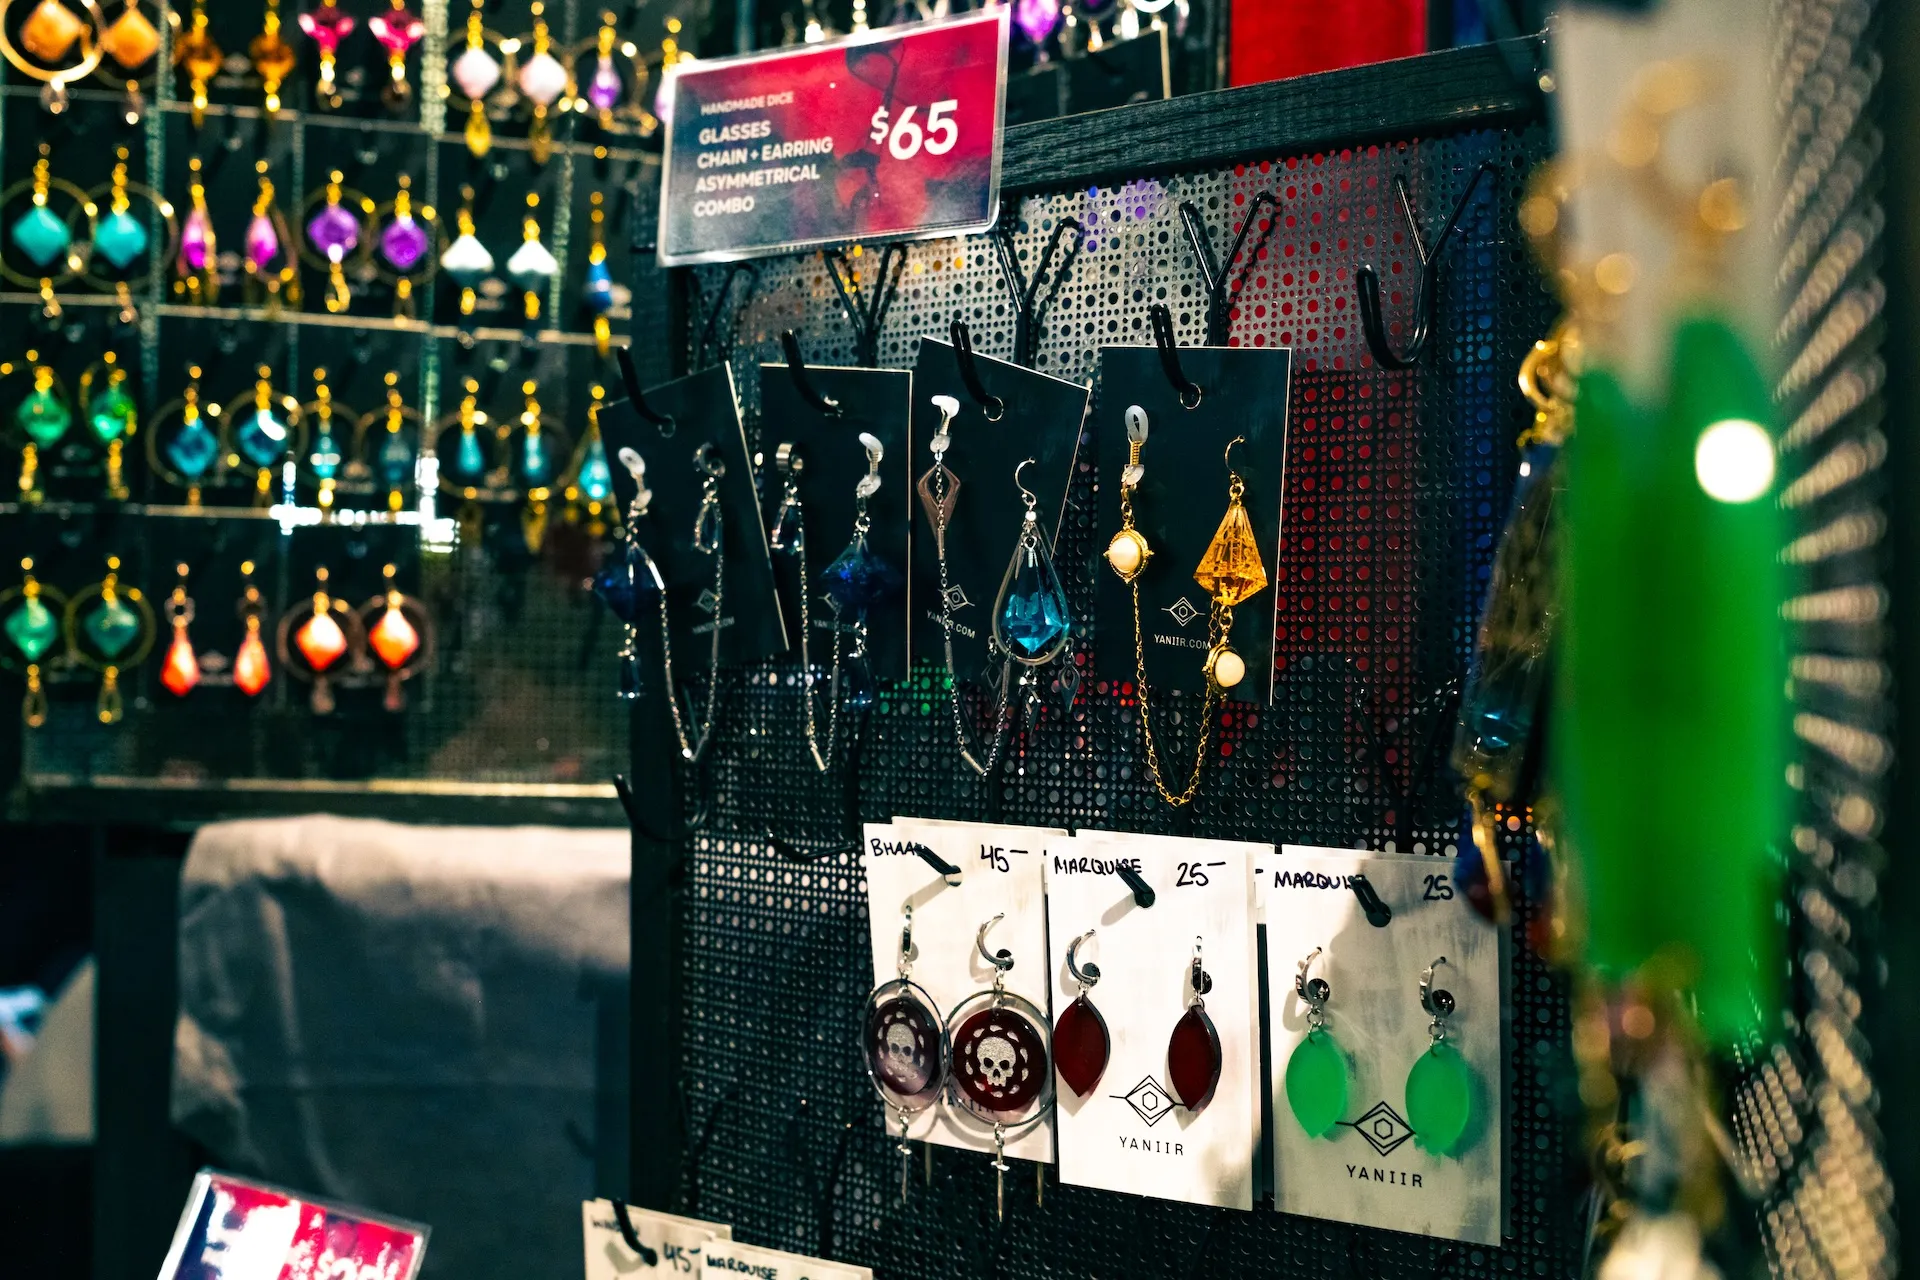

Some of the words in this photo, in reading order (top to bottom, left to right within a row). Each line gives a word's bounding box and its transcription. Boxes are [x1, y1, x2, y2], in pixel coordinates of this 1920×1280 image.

[701, 94, 765, 116] HANDMADE
[767, 91, 794, 108] DICE
[699, 120, 771, 145] GLASSES
[870, 99, 958, 160] $65
[697, 147, 748, 169] CHAIN
[761, 136, 833, 161] EARRING
[695, 163, 820, 194] ASYMMETRICAL
[693, 195, 755, 217] COMBO
[871, 838, 918, 857] BHAA
[1119, 1136, 1184, 1156] YANIIR
[1346, 1164, 1422, 1188] YANIIR
